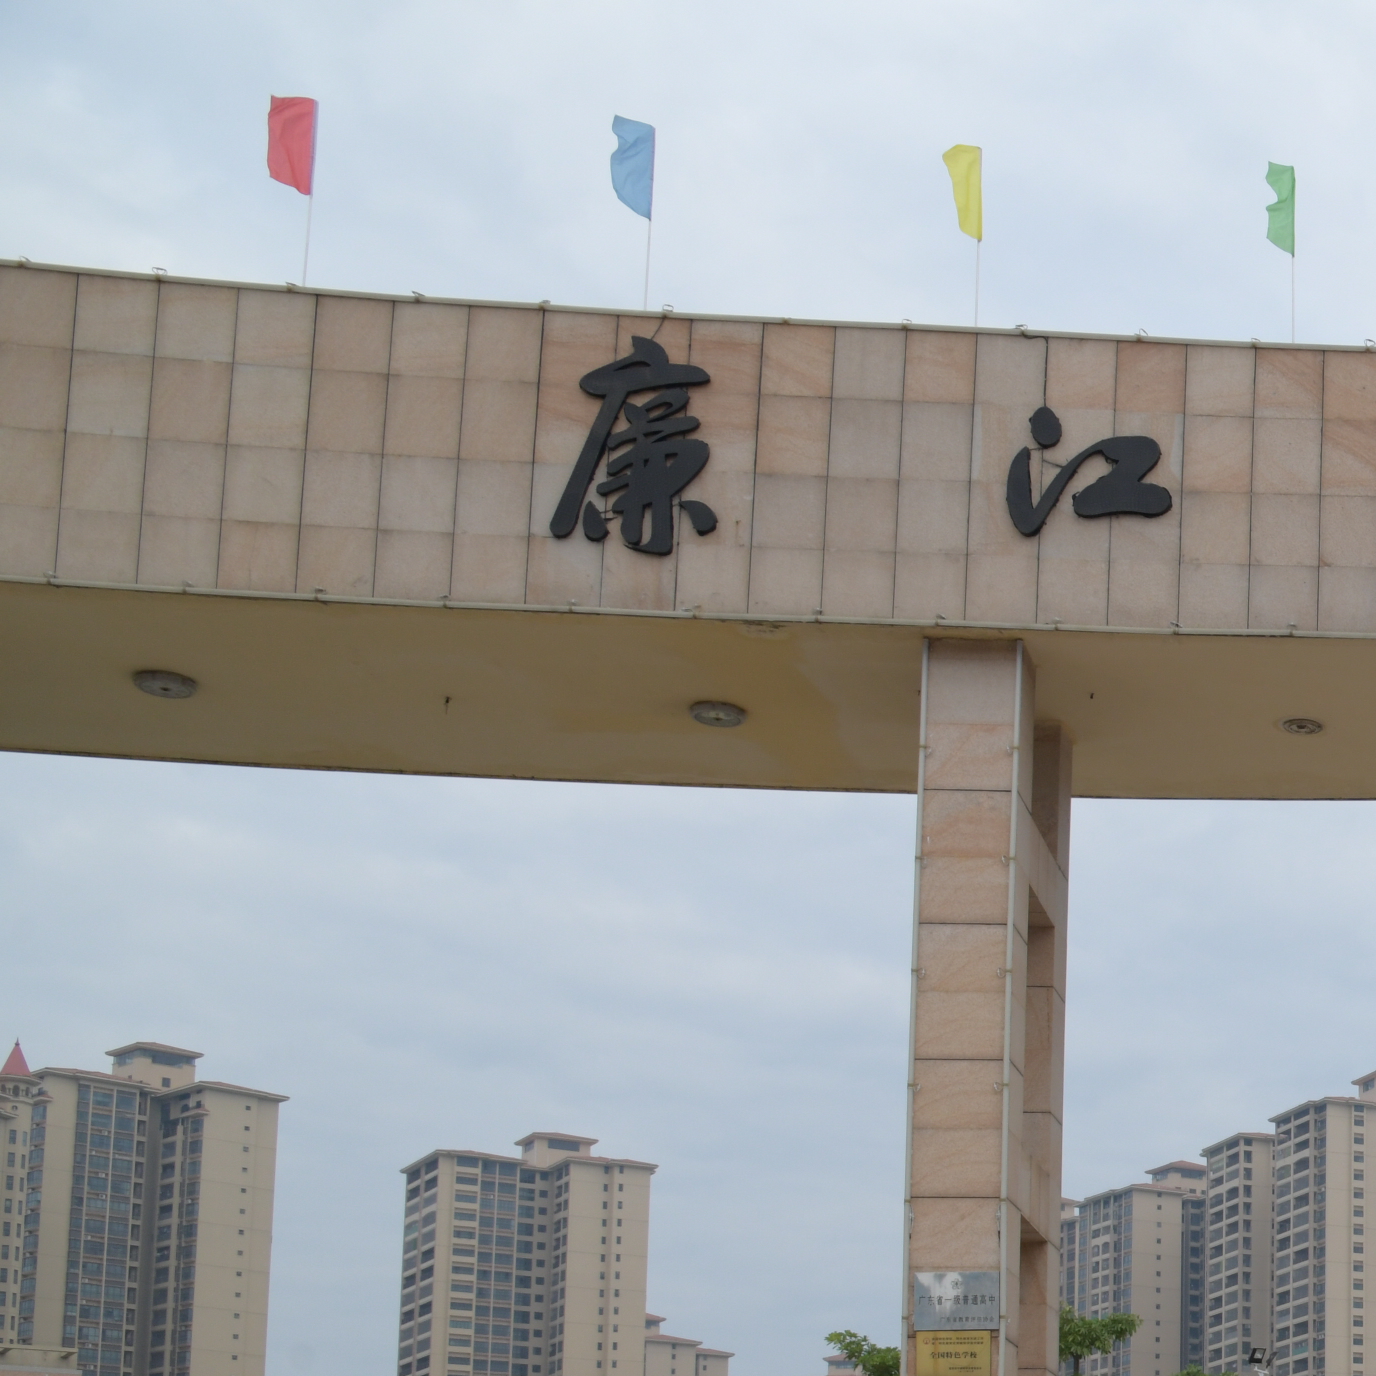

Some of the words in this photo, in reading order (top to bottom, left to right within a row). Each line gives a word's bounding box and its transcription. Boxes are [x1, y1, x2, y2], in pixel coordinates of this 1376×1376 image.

[918, 1294, 996, 1306] 广东省一级普通高中
[930, 1351, 978, 1359] 全国特色学校
